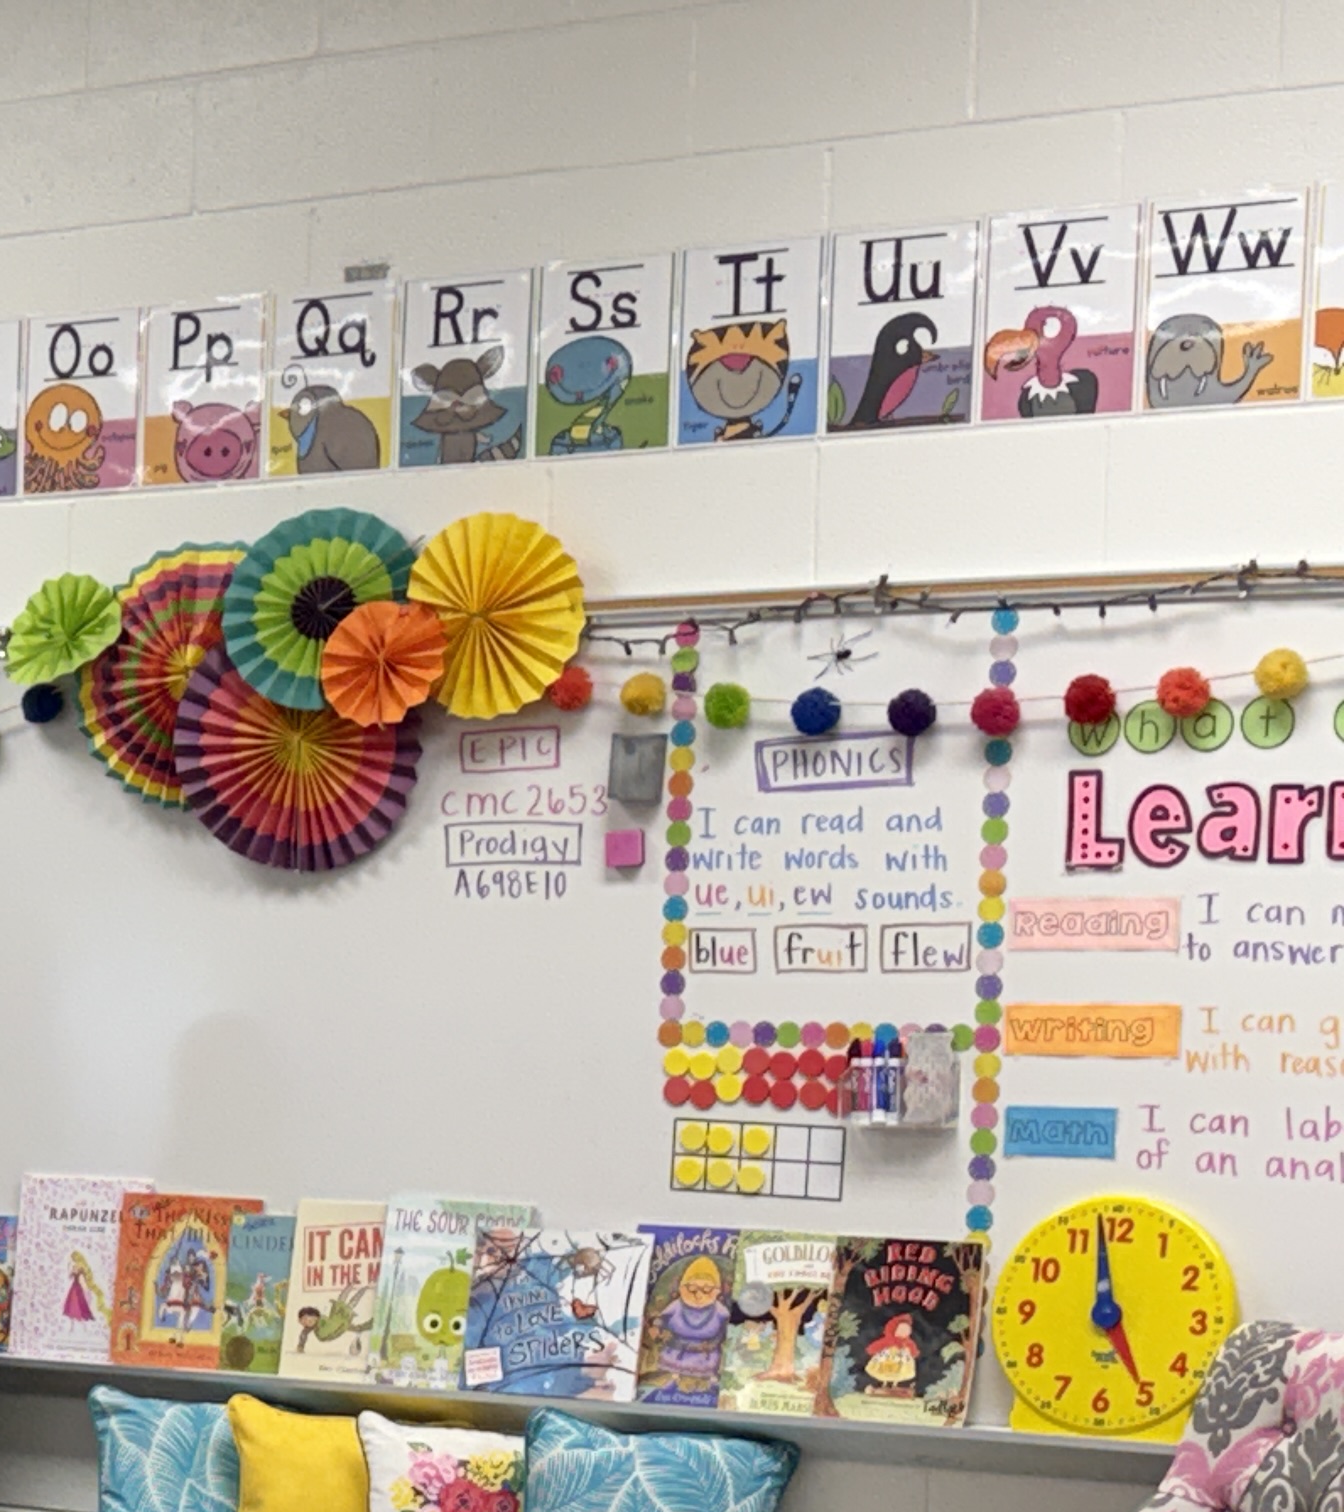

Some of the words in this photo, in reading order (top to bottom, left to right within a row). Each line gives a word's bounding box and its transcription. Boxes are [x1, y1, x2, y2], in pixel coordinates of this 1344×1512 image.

[1023, 223, 1104, 287] Vv
[1163, 208, 1291, 276] Ww
[718, 254, 784, 316] Tt
[863, 238, 943, 302] Uu
[432, 286, 500, 347] Rr
[569, 271, 638, 332] Ss
[171, 312, 234, 382] Pp
[297, 300, 376, 367] Qq
[49, 323, 114, 379] Oo
[470, 732, 552, 764] EPIC
[770, 746, 903, 782] PHONICS
[698, 806, 717, 838] I
[735, 812, 781, 836] can
[801, 806, 864, 834] read
[886, 807, 944, 834] and
[458, 828, 571, 865] Prodigy
[692, 844, 763, 872] write
[784, 844, 859, 872] words
[885, 843, 949, 872] with
[1014, 909, 1170, 940] Reading
[1197, 892, 1220, 925] I
[1246, 902, 1307, 926] can
[694, 931, 750, 967] blue
[783, 925, 864, 967] fruit
[891, 927, 967, 967] flew
[1183, 931, 1212, 962] to
[1199, 1006, 1221, 1035] I
[1241, 1012, 1297, 1035] can
[1185, 1042, 1250, 1074] with
[1011, 1117, 1109, 1146] Math
[1138, 1104, 1167, 1134] I
[1189, 1112, 1250, 1138] can
[1136, 1137, 1171, 1171] of
[1195, 1151, 1239, 1178] an
[395, 1207, 423, 1233] THE
[427, 1209, 470, 1236] SOUR
[1106, 1217, 1135, 1243] 12
[307, 1228, 333, 1263] IT
[886, 1242, 939, 1265] RED
[1067, 1228, 1089, 1254] 11
[1158, 1233, 1168, 1258] 1
[306, 1264, 324, 1287] IN
[329, 1262, 362, 1287] THE
[864, 1263, 956, 1295] RIDING
[1031, 1257, 1060, 1283] 10
[1181, 1265, 1200, 1291] 2
[872, 1284, 941, 1312] HOOD
[1017, 1299, 1036, 1325] 9
[1188, 1309, 1208, 1335] 3
[1025, 1342, 1044, 1368] 8
[1169, 1352, 1189, 1378] 4
[1054, 1375, 1072, 1401] 7
[1092, 1388, 1110, 1413] 6
[1136, 1381, 1155, 1407] 5
